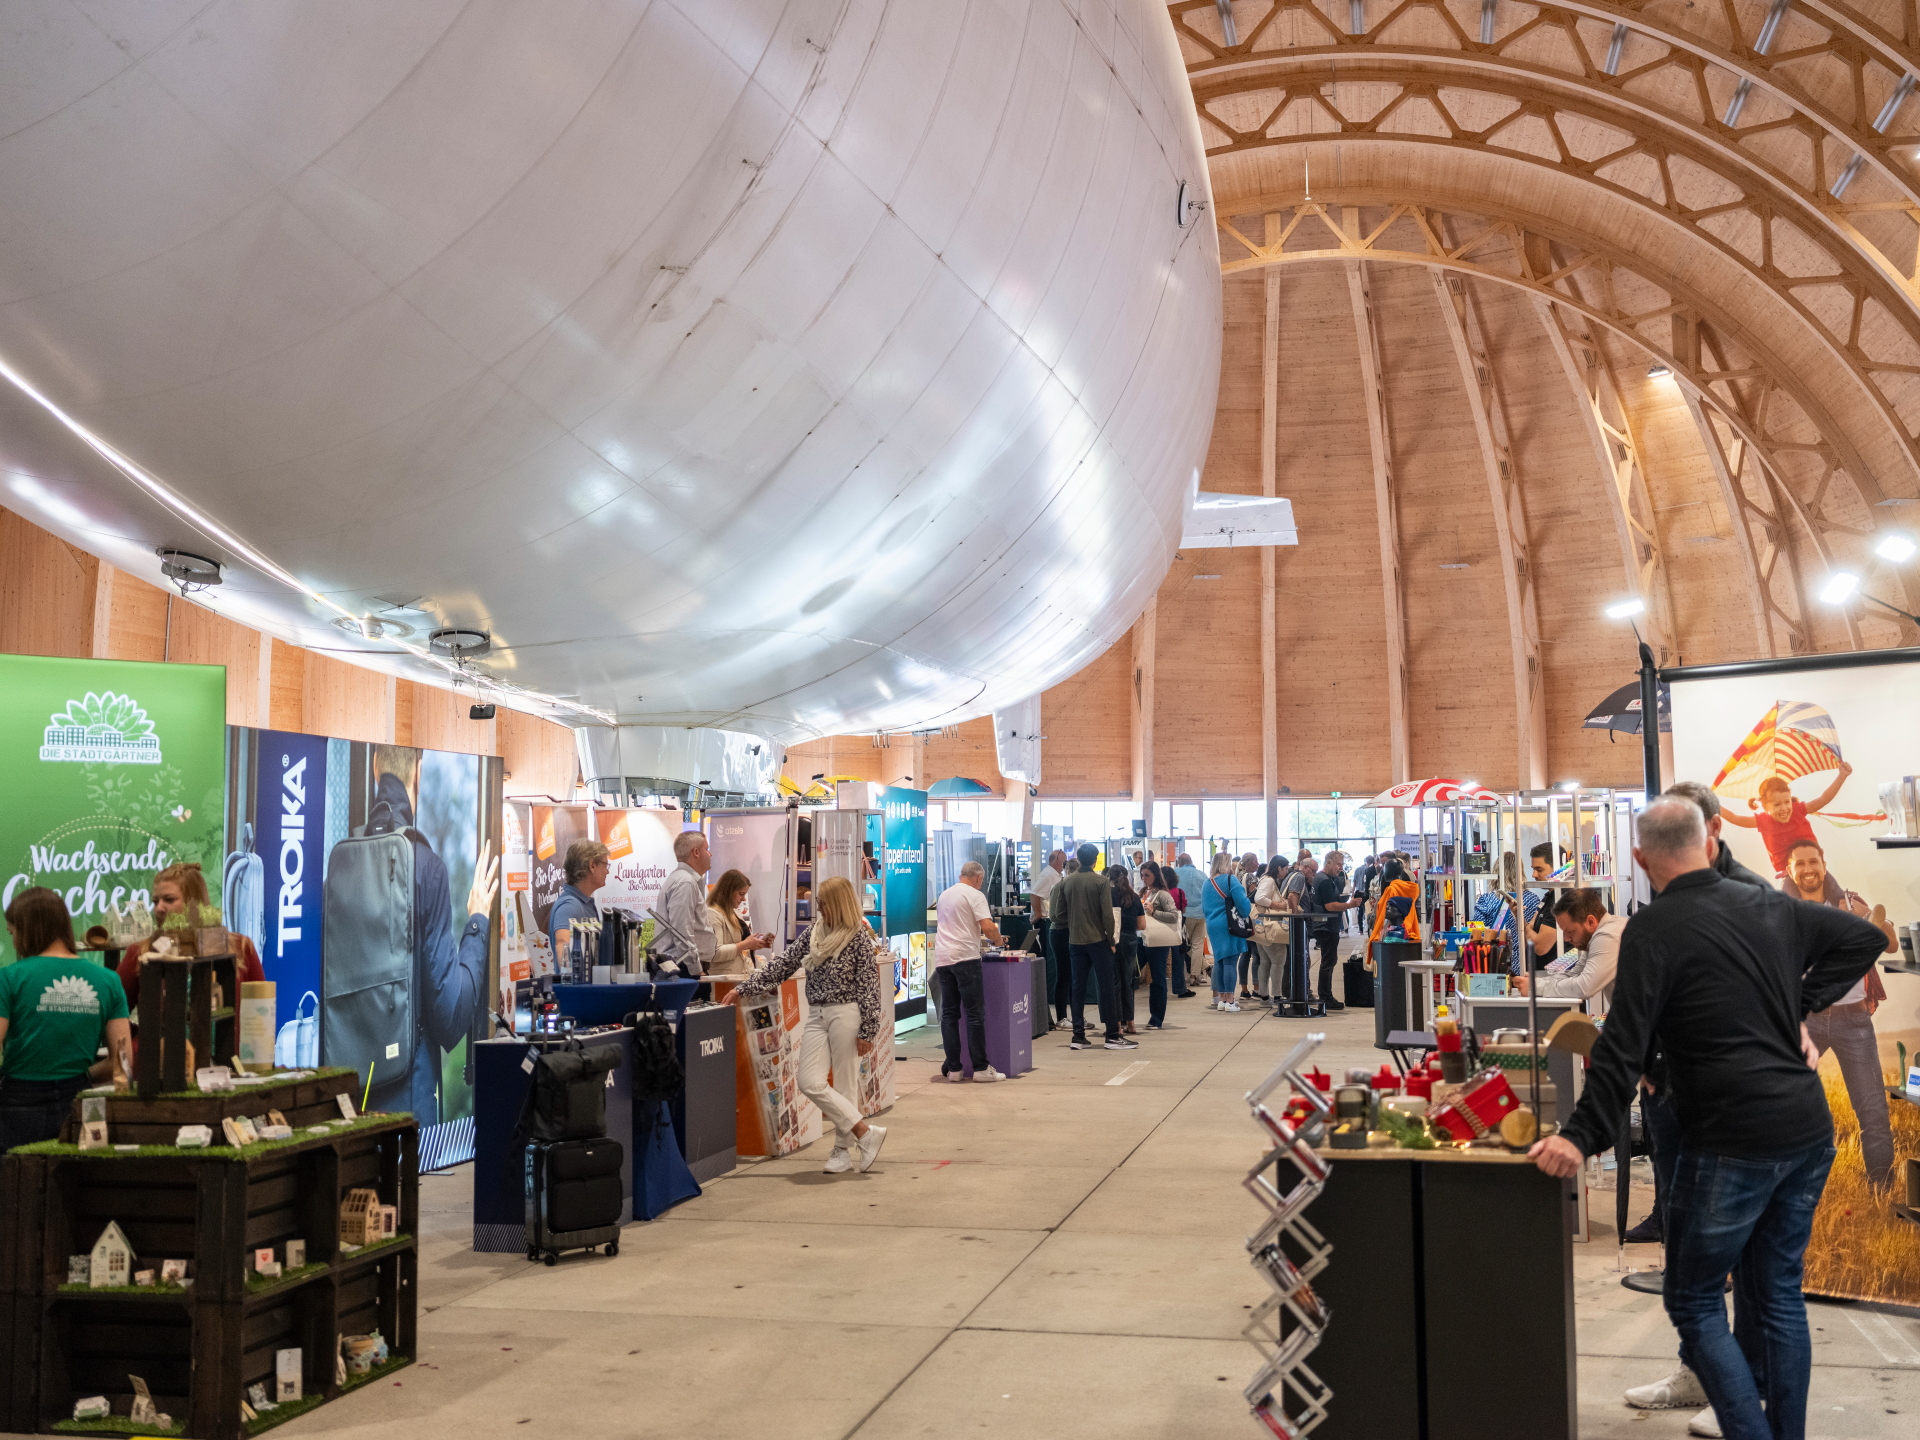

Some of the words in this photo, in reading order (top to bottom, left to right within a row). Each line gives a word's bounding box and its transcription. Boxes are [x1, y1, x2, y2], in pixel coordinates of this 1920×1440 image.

[42, 748, 60, 758] DIE
[64, 748, 159, 761] STADTGÄRTNER
[30, 840, 173, 875] Wachsende
[535, 867, 548, 888] Bio
[614, 862, 667, 882] Landgarten
